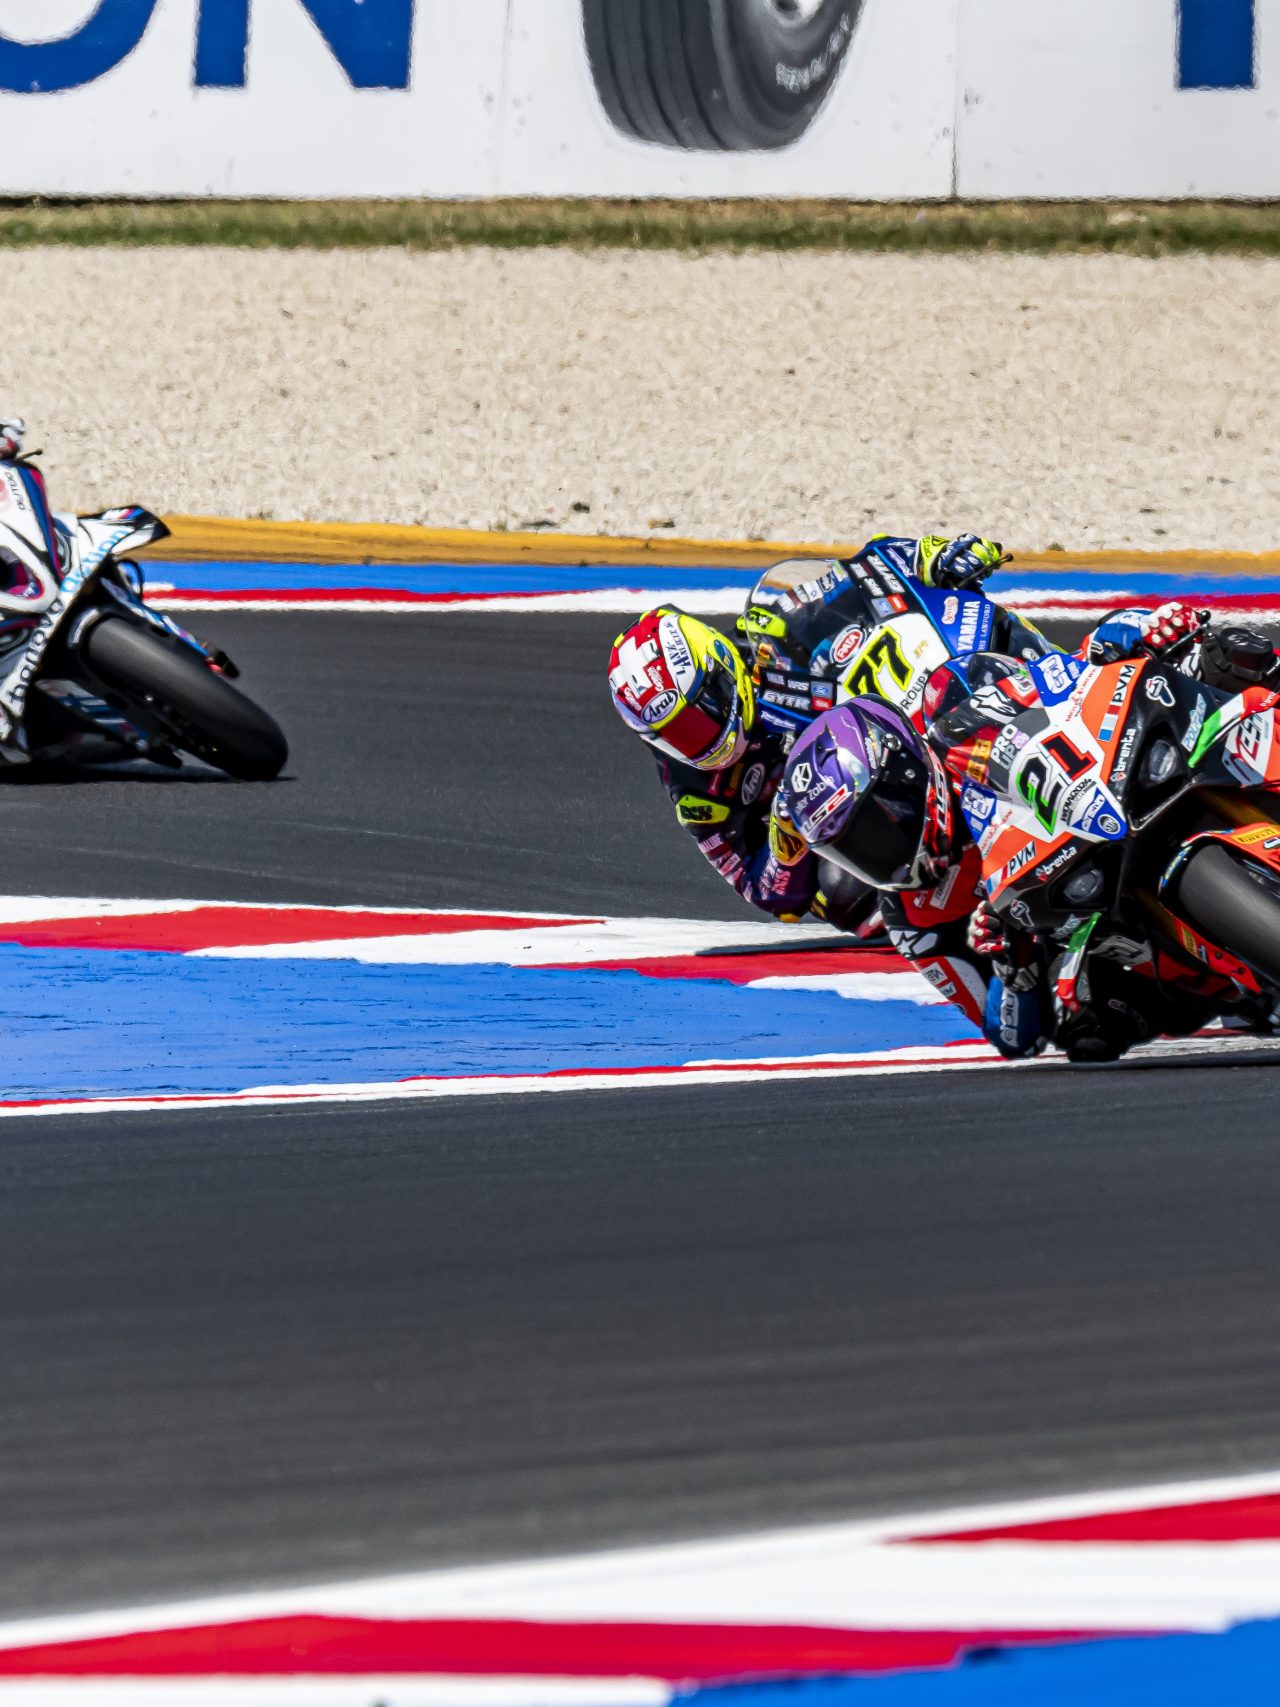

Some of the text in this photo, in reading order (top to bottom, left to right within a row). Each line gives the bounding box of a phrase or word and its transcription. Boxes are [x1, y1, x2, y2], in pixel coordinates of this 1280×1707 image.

[60, 530, 130, 593] action
[840, 633, 859, 658] PATA
[957, 601, 981, 652] YAMAHA
[843, 624, 915, 702] 77
[900, 674, 926, 711] ROUP
[1113, 664, 1136, 703] PVM
[649, 692, 674, 720] Arai
[990, 724, 1018, 766] PRO
[1016, 731, 1097, 836] 21
[801, 784, 852, 836] LS2
[1238, 828, 1276, 843] PIRELLI
[1009, 841, 1036, 876] PVM
